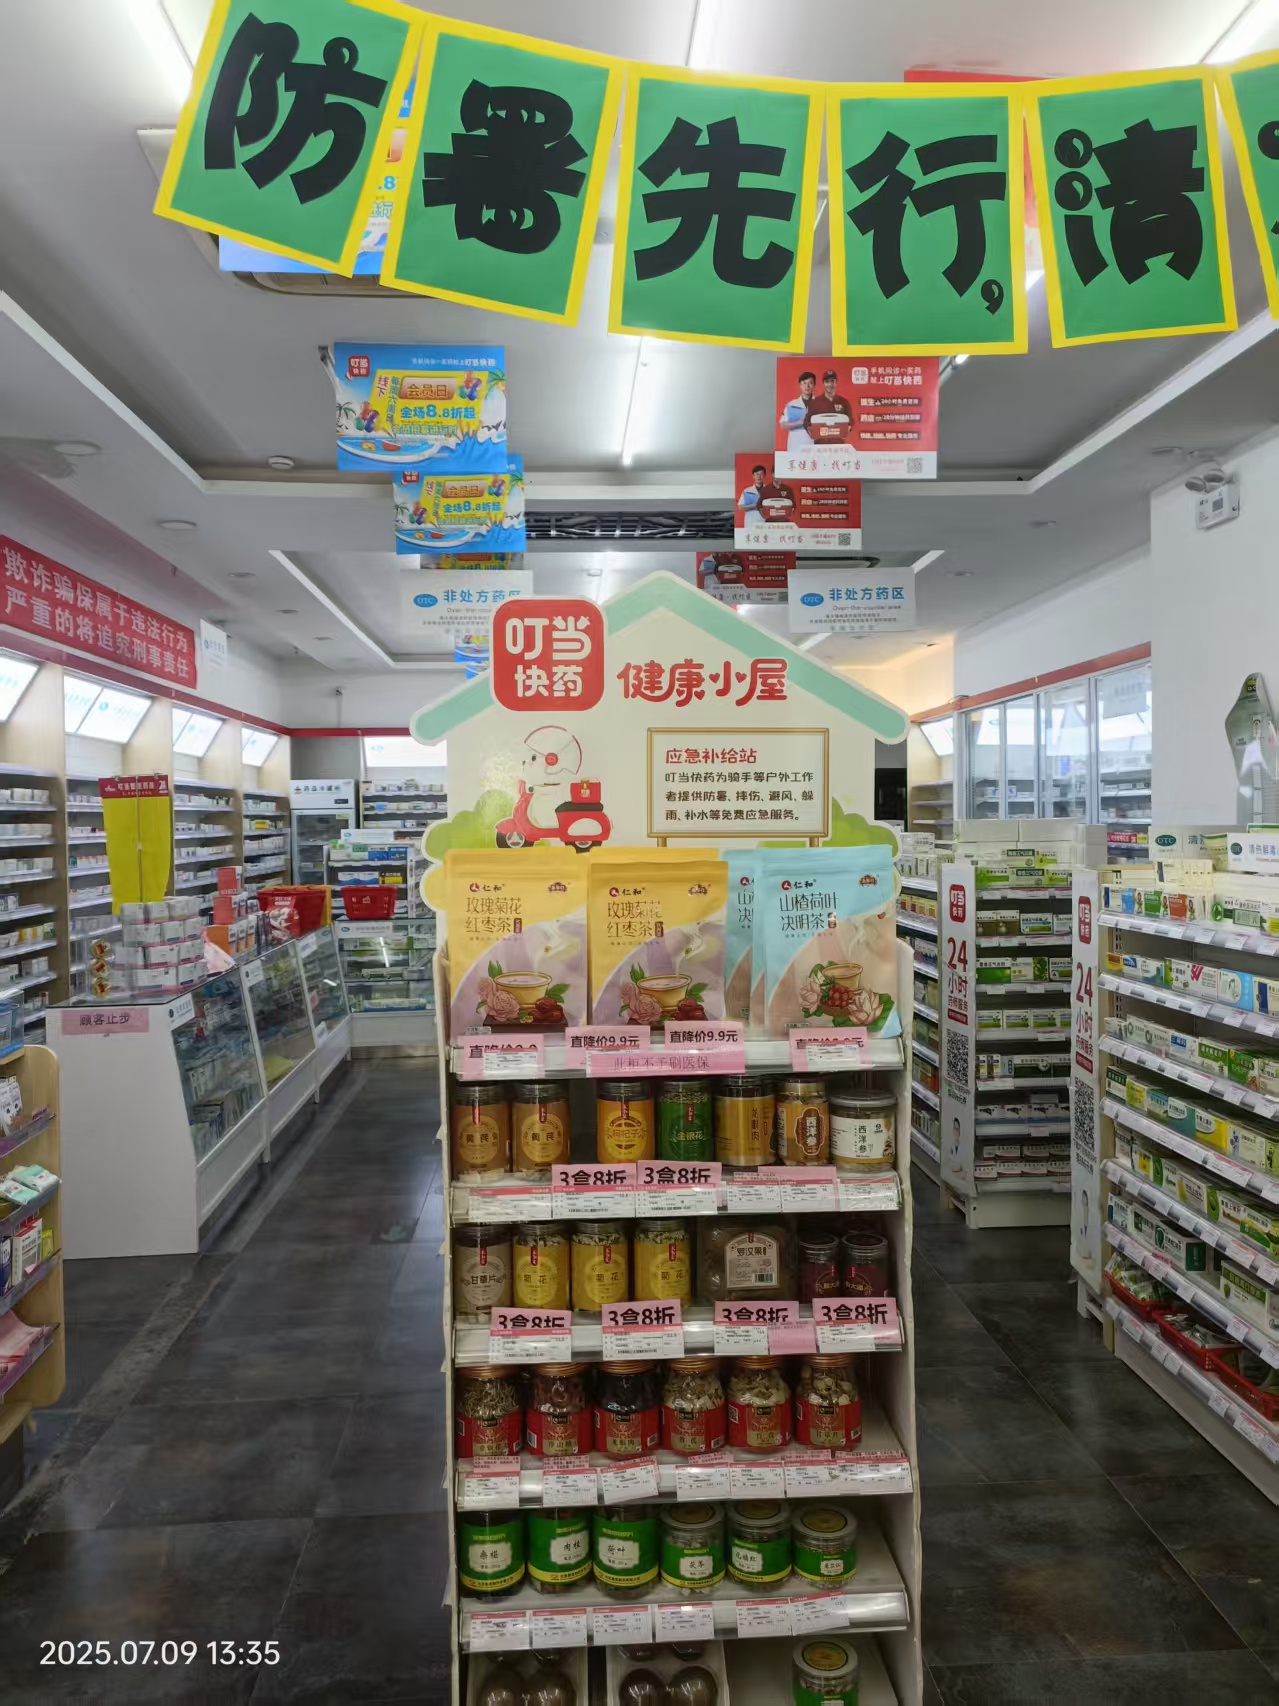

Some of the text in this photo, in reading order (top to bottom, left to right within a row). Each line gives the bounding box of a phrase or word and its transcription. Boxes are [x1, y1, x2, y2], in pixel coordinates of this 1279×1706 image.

[407, 383, 448, 398] 会员日
[400, 404, 476, 420] 全场8.8折起
[4, 546, 187, 653] 欺诈骗保属于违法行为
[829, 587, 905, 601] 非处方药区
[5, 585, 189, 679] 严重的将追究刑事责任
[506, 615, 592, 661] 叮当
[514, 665, 583, 697] 快药
[616, 658, 788, 707] 健康小屋
[665, 747, 758, 764] 应急补给站
[665, 771, 814, 783] 叮当快药为骑手等户外工作
[665, 790, 814, 802] 者提供防暑、摔伤、避风、躲
[665, 809, 800, 821] 雨、补水等免费应急服务。
[1157, 836, 1175, 844] OTC
[482, 884, 502, 892] 仁和
[622, 888, 642, 896] 仁和
[793, 880, 814, 889] 仁和
[466, 897, 522, 915] 玫瑰菊花
[779, 892, 839, 912] 山楂荷叶
[951, 890, 964, 906] 叮当
[607, 900, 663, 918] 玫瑰菊花
[465, 916, 512, 933] 红枣茶
[781, 911, 825, 931] 决明茶
[607, 921, 653, 938] 红枣茶
[947, 937, 968, 973] 24
[948, 973, 968, 999] 小时
[1076, 962, 1093, 1007] 24
[79, 1012, 131, 1026] 顾客止步
[1076, 1011, 1093, 1040] 小时
[570, 1034, 640, 1048] 直降价9.9元
[669, 1030, 739, 1044] 直降价9.9元
[612, 1128, 641, 1139] 枸杞子
[677, 1131, 705, 1142] 金银花
[858, 1125, 867, 1154] 西洋参
[560, 1169, 627, 1185] 3盒8折
[644, 1166, 711, 1184] 3盒8折
[736, 1246, 762, 1257] 罗汉果
[471, 1274, 497, 1285] 甘草片
[608, 1306, 675, 1326] 3盒8折
[722, 1307, 789, 1322] 3盒8折
[821, 1304, 888, 1325] 3盒8折
[564, 1540, 581, 1552] 肉桂
[607, 1545, 626, 1556] 荷叶
